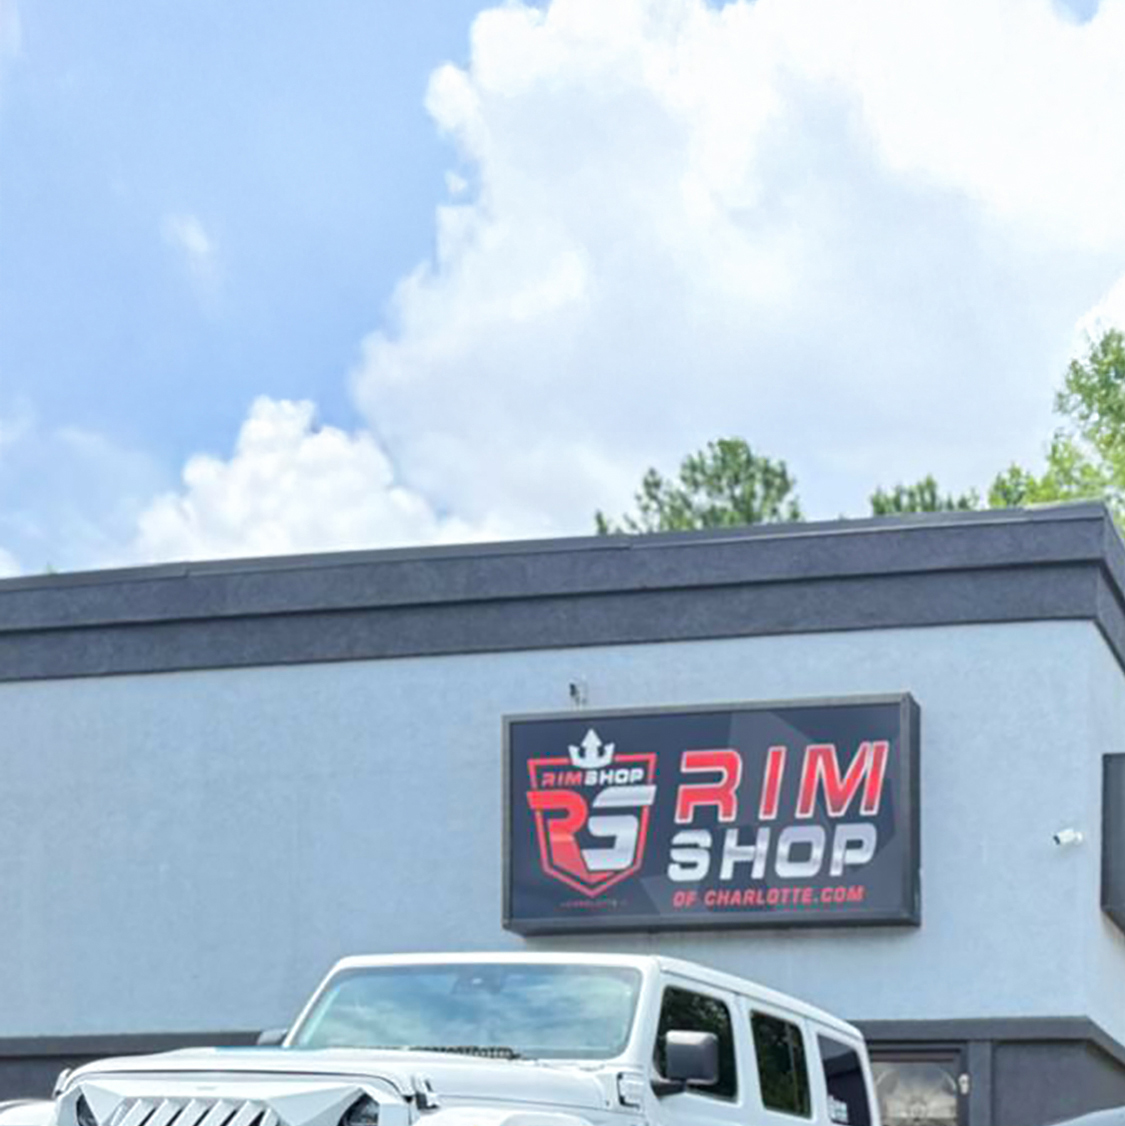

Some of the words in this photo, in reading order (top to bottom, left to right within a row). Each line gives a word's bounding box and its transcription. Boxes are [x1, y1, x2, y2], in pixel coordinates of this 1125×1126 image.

[674, 741, 889, 824] RIM
[667, 822, 877, 882] SHOP
[672, 891, 698, 907] OF
[704, 885, 865, 906] CHARLOTTE.COM
